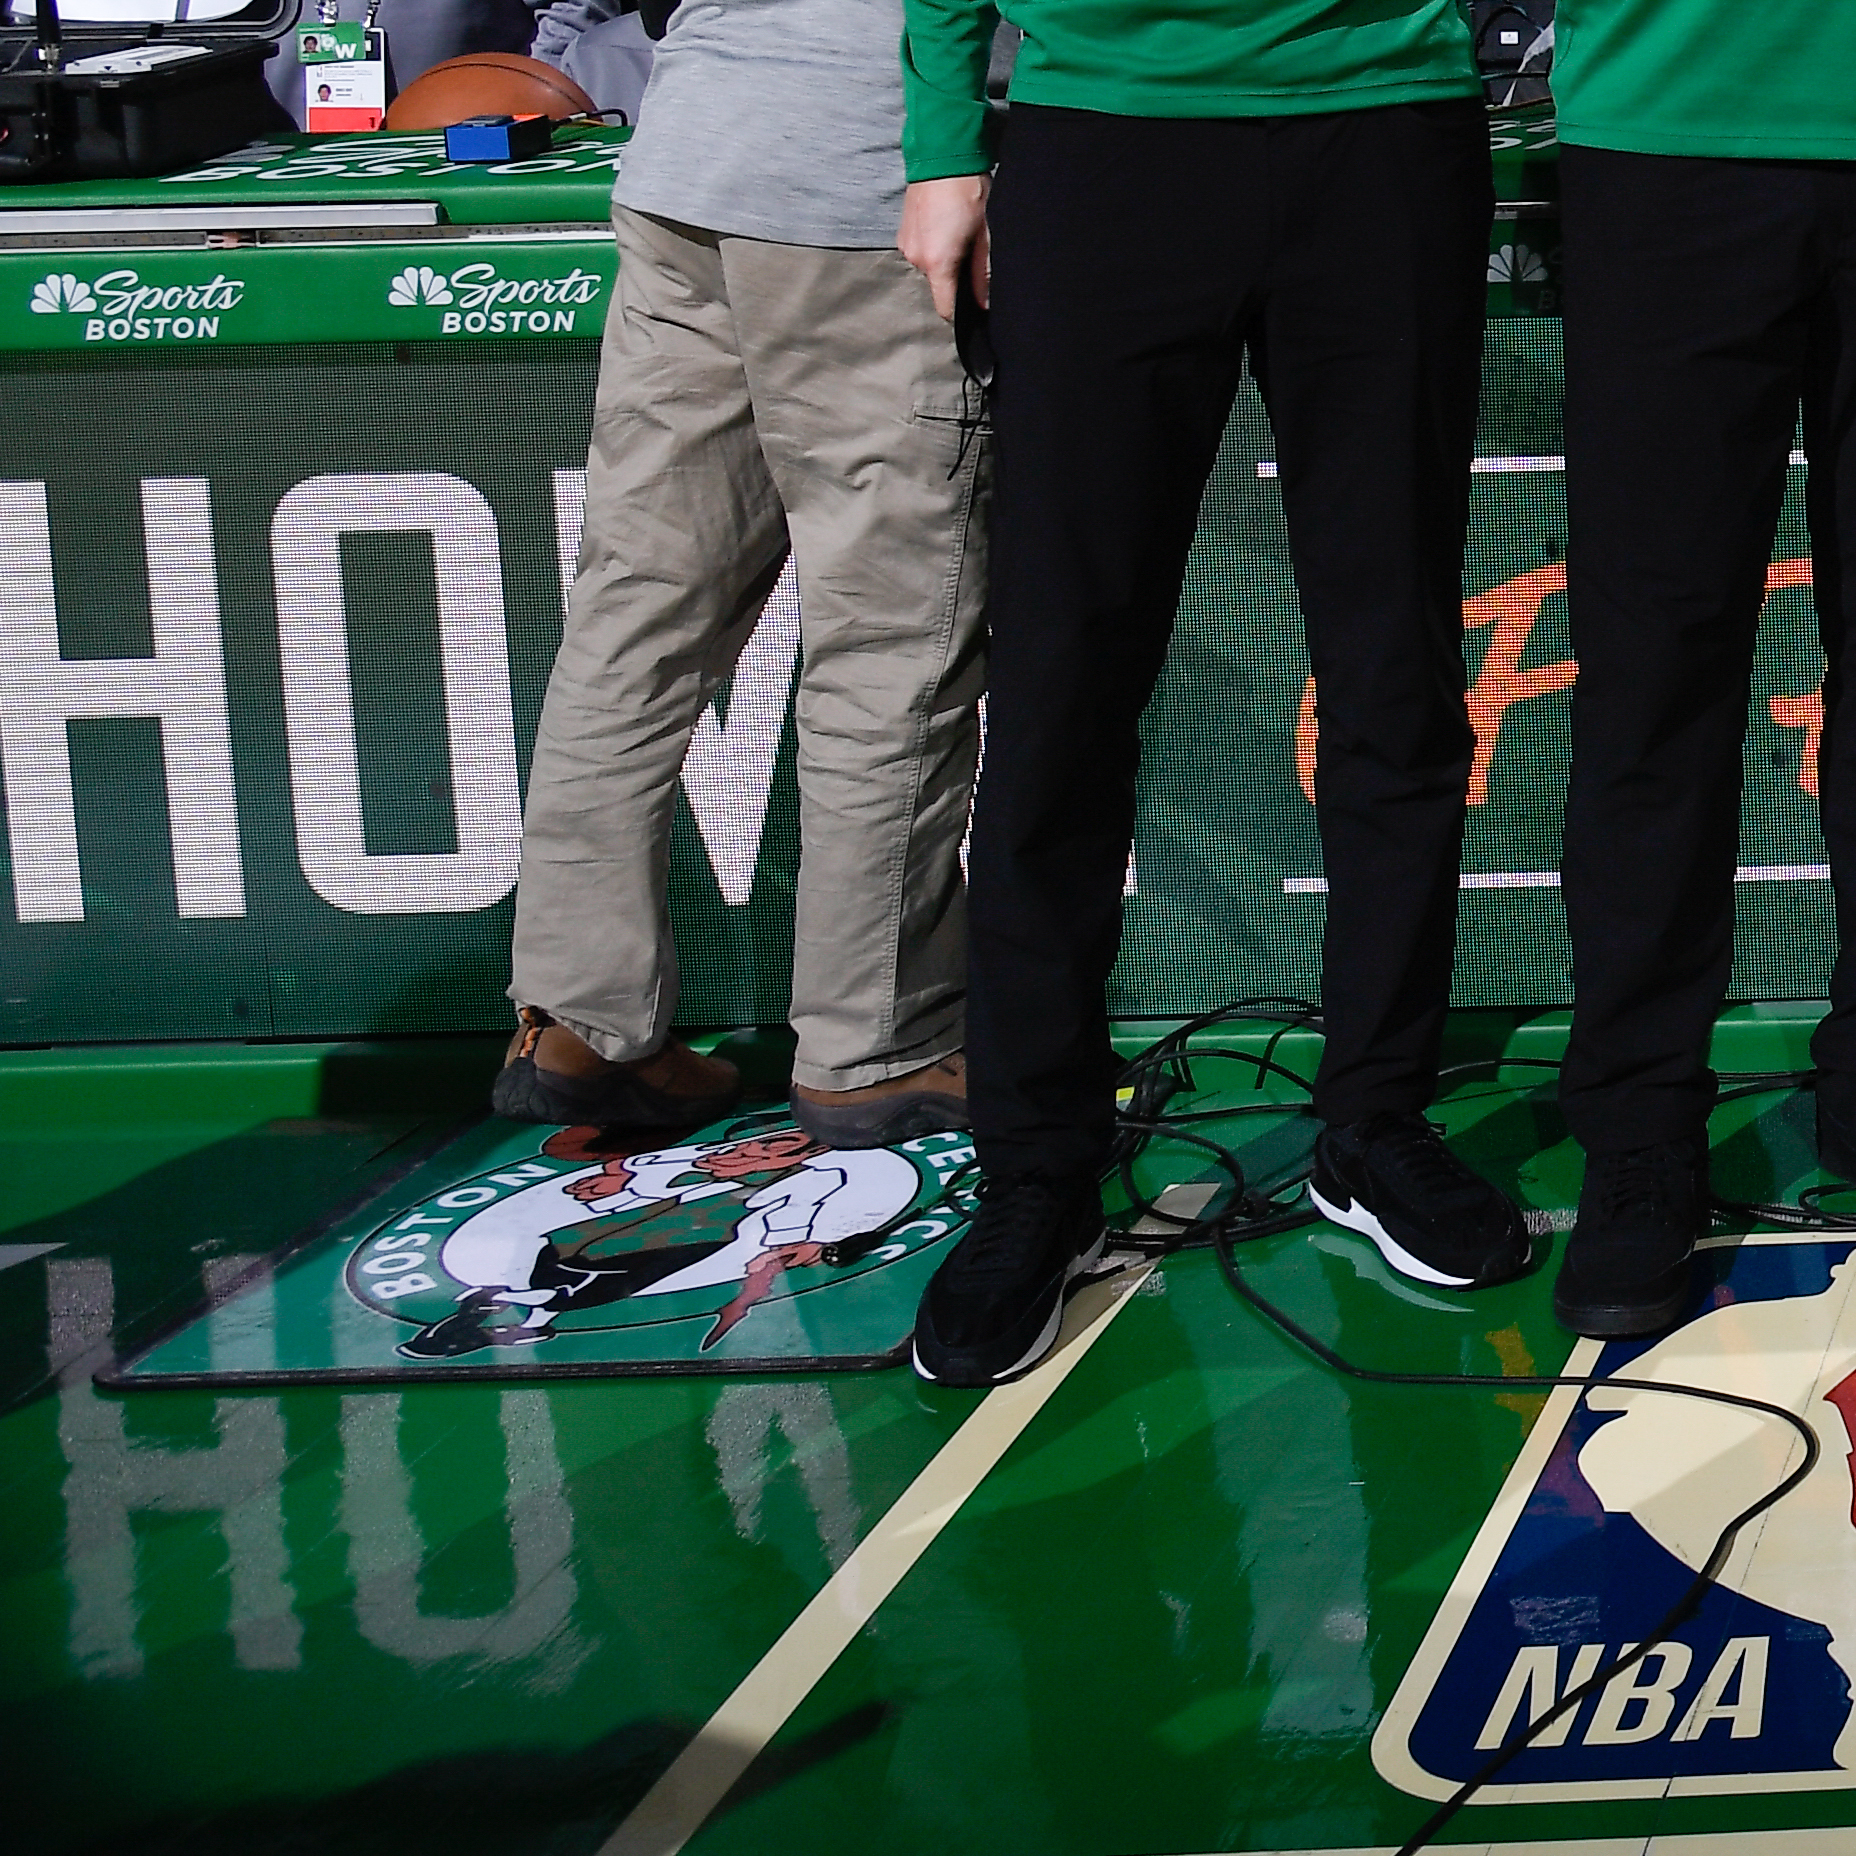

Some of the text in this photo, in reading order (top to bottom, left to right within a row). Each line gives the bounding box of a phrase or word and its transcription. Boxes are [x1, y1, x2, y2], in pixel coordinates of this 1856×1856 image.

[93, 269, 247, 324] Sports
[449, 262, 603, 318] Sports
[84, 317, 221, 342] BOSTON
[440, 310, 577, 335] BOSTON
[361, 1161, 560, 1301] BOSTON
[1472, 1633, 1772, 1754] NBA
